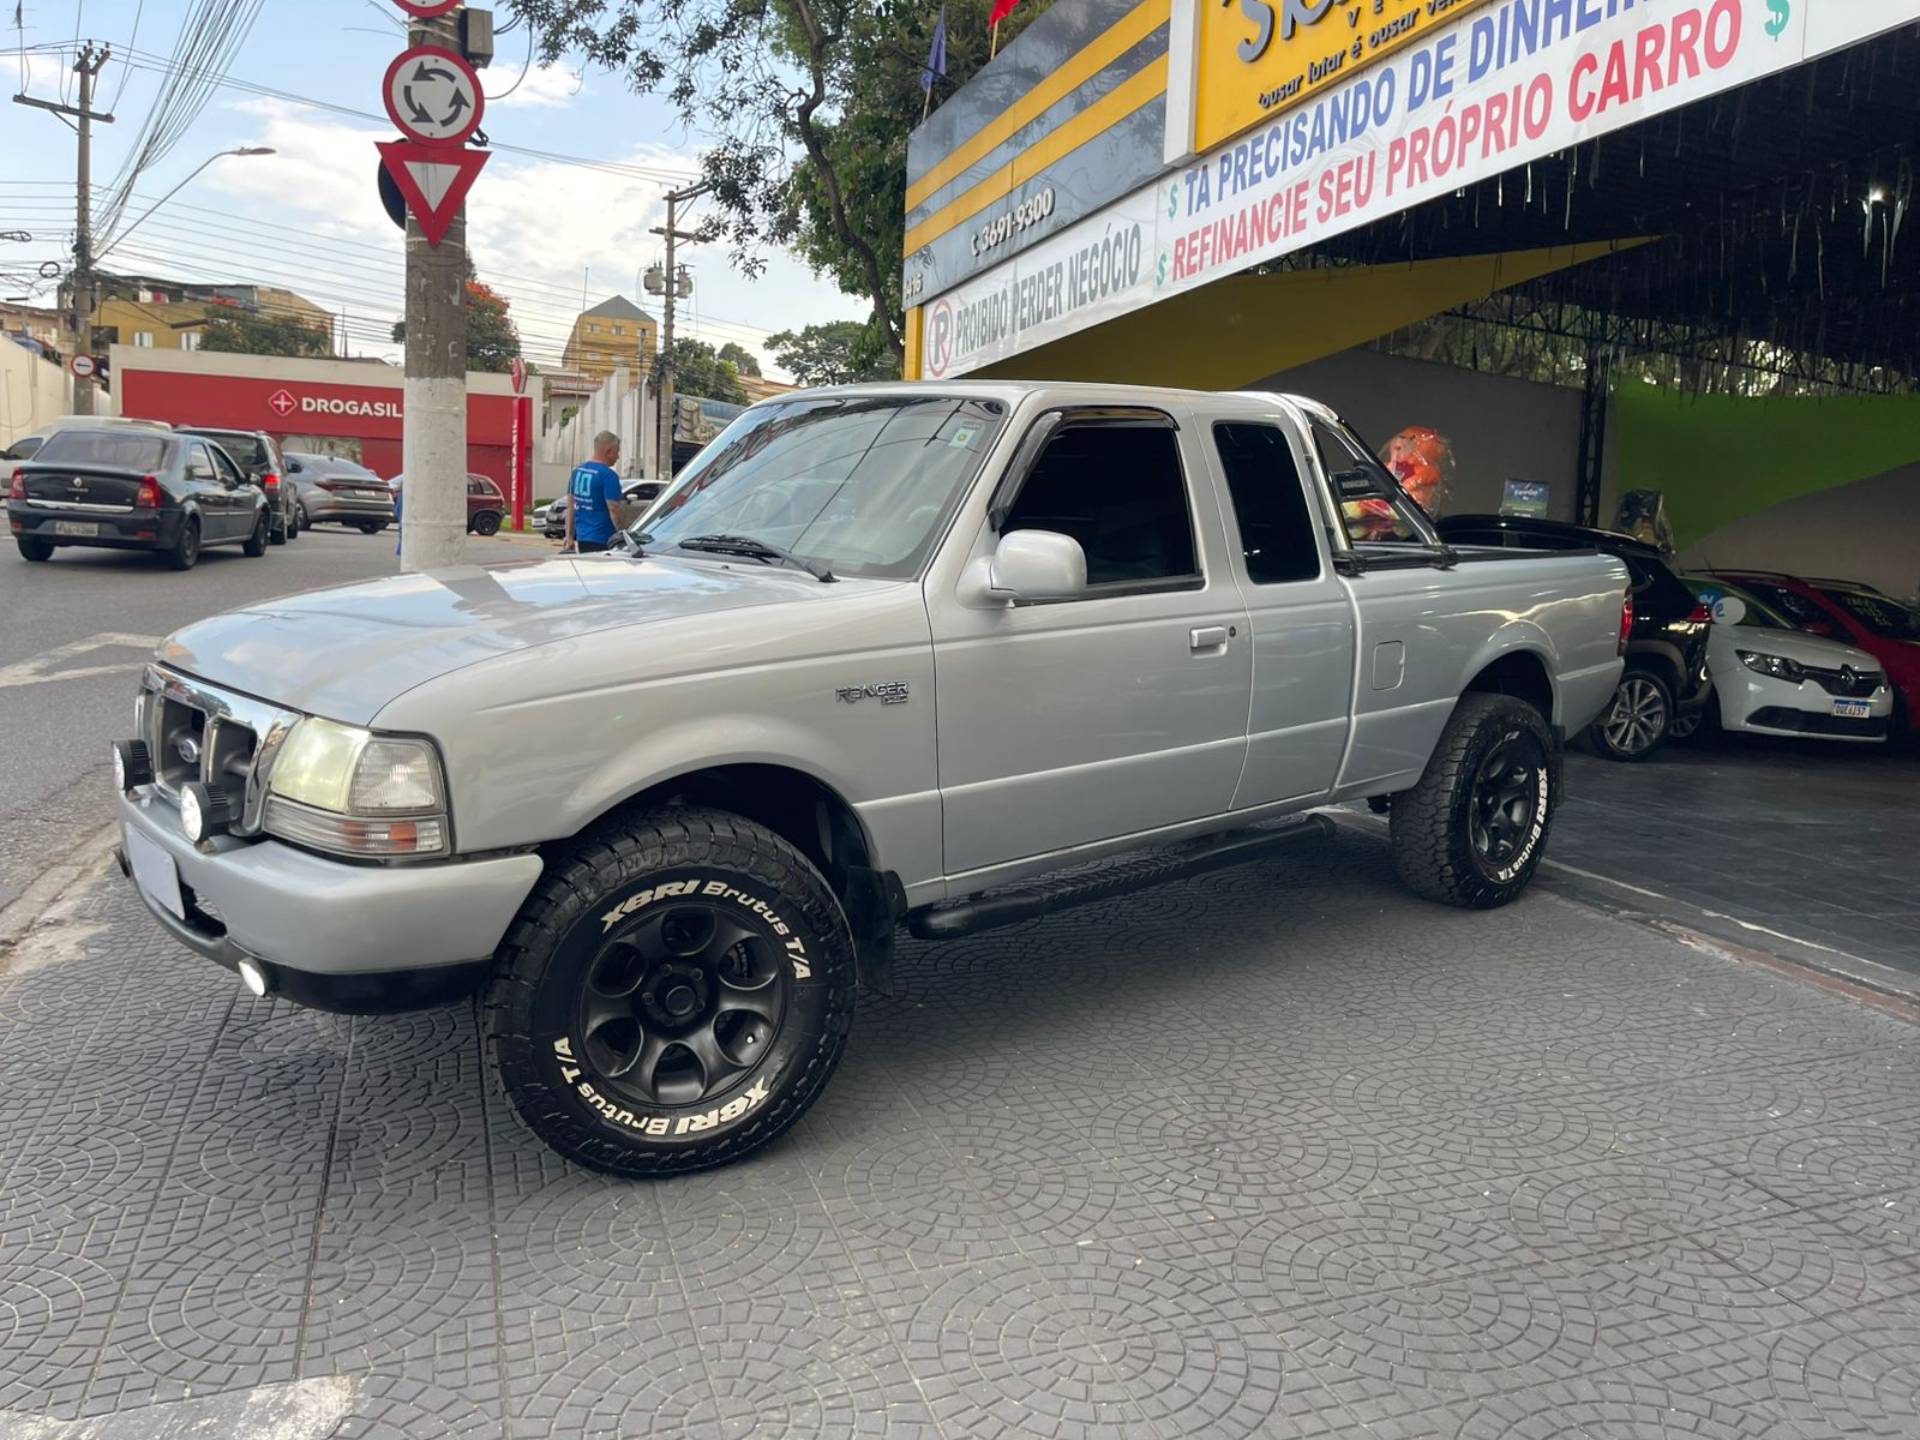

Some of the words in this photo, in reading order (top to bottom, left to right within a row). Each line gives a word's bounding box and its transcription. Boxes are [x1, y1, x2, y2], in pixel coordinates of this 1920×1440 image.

[1308, 49, 1346, 84] lutar
[1352, 35, 1363, 60] é
[1368, 8, 1420, 48] ousar
[1172, 180, 1310, 281] REFINANCIE
[1316, 150, 1376, 224] SEU
[1385, 73, 1552, 197] PRÓPRIO
[1568, 0, 1742, 123] CARRO
[1218, 67, 1396, 202] PRECISANDO
[1408, 33, 1457, 112] DE
[982, 188, 1055, 251] 3691-9300
[955, 288, 1008, 357] PROIBIDO
[1012, 262, 1064, 334] PERDER
[1068, 223, 1141, 310] NEGÓCIO
[301, 397, 403, 418] DROGASIL
[574, 471, 592, 497] 10
[1513, 824, 1542, 871] Brutus
[601, 880, 702, 934] XBRI
[702, 881, 790, 936] Brutus
[785, 937, 812, 979] T/A
[553, 1036, 582, 1085] T/A
[577, 1083, 670, 1135] Brutus
[674, 1075, 769, 1135] XBRI
